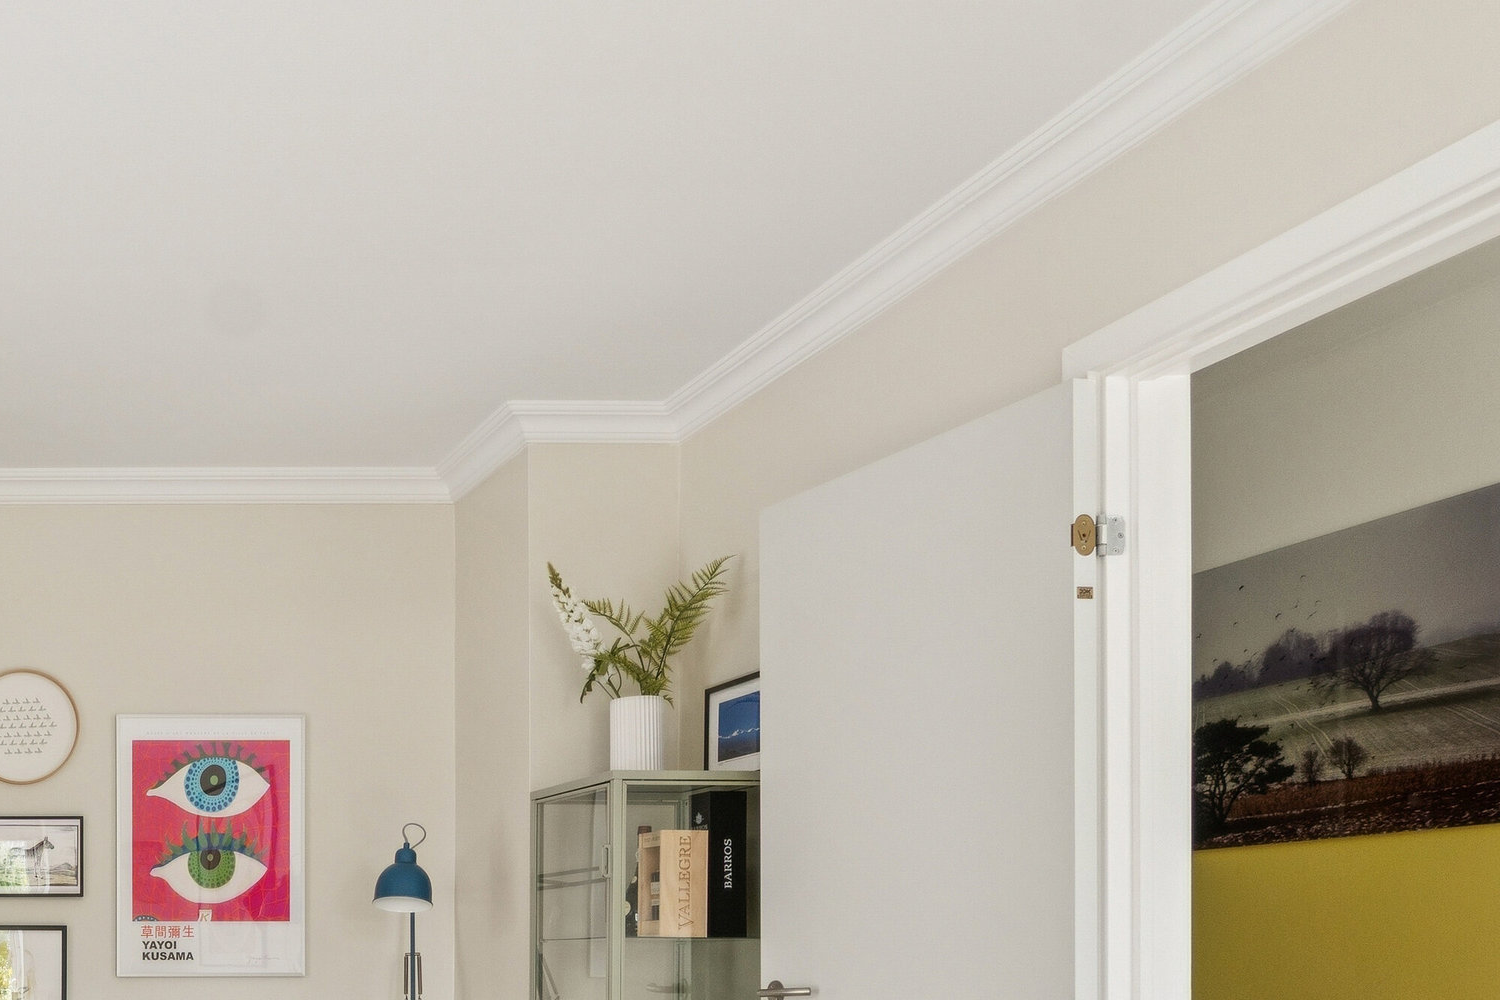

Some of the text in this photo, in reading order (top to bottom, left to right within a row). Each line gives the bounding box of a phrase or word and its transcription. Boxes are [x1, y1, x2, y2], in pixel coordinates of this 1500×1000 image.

[723, 838, 732, 889] BARROS
[677, 835, 694, 930] VALLEGRE
[141, 925, 194, 938] 草間彌生
[142, 941, 177, 949] YAYOI
[142, 952, 194, 960] KUSAMA
